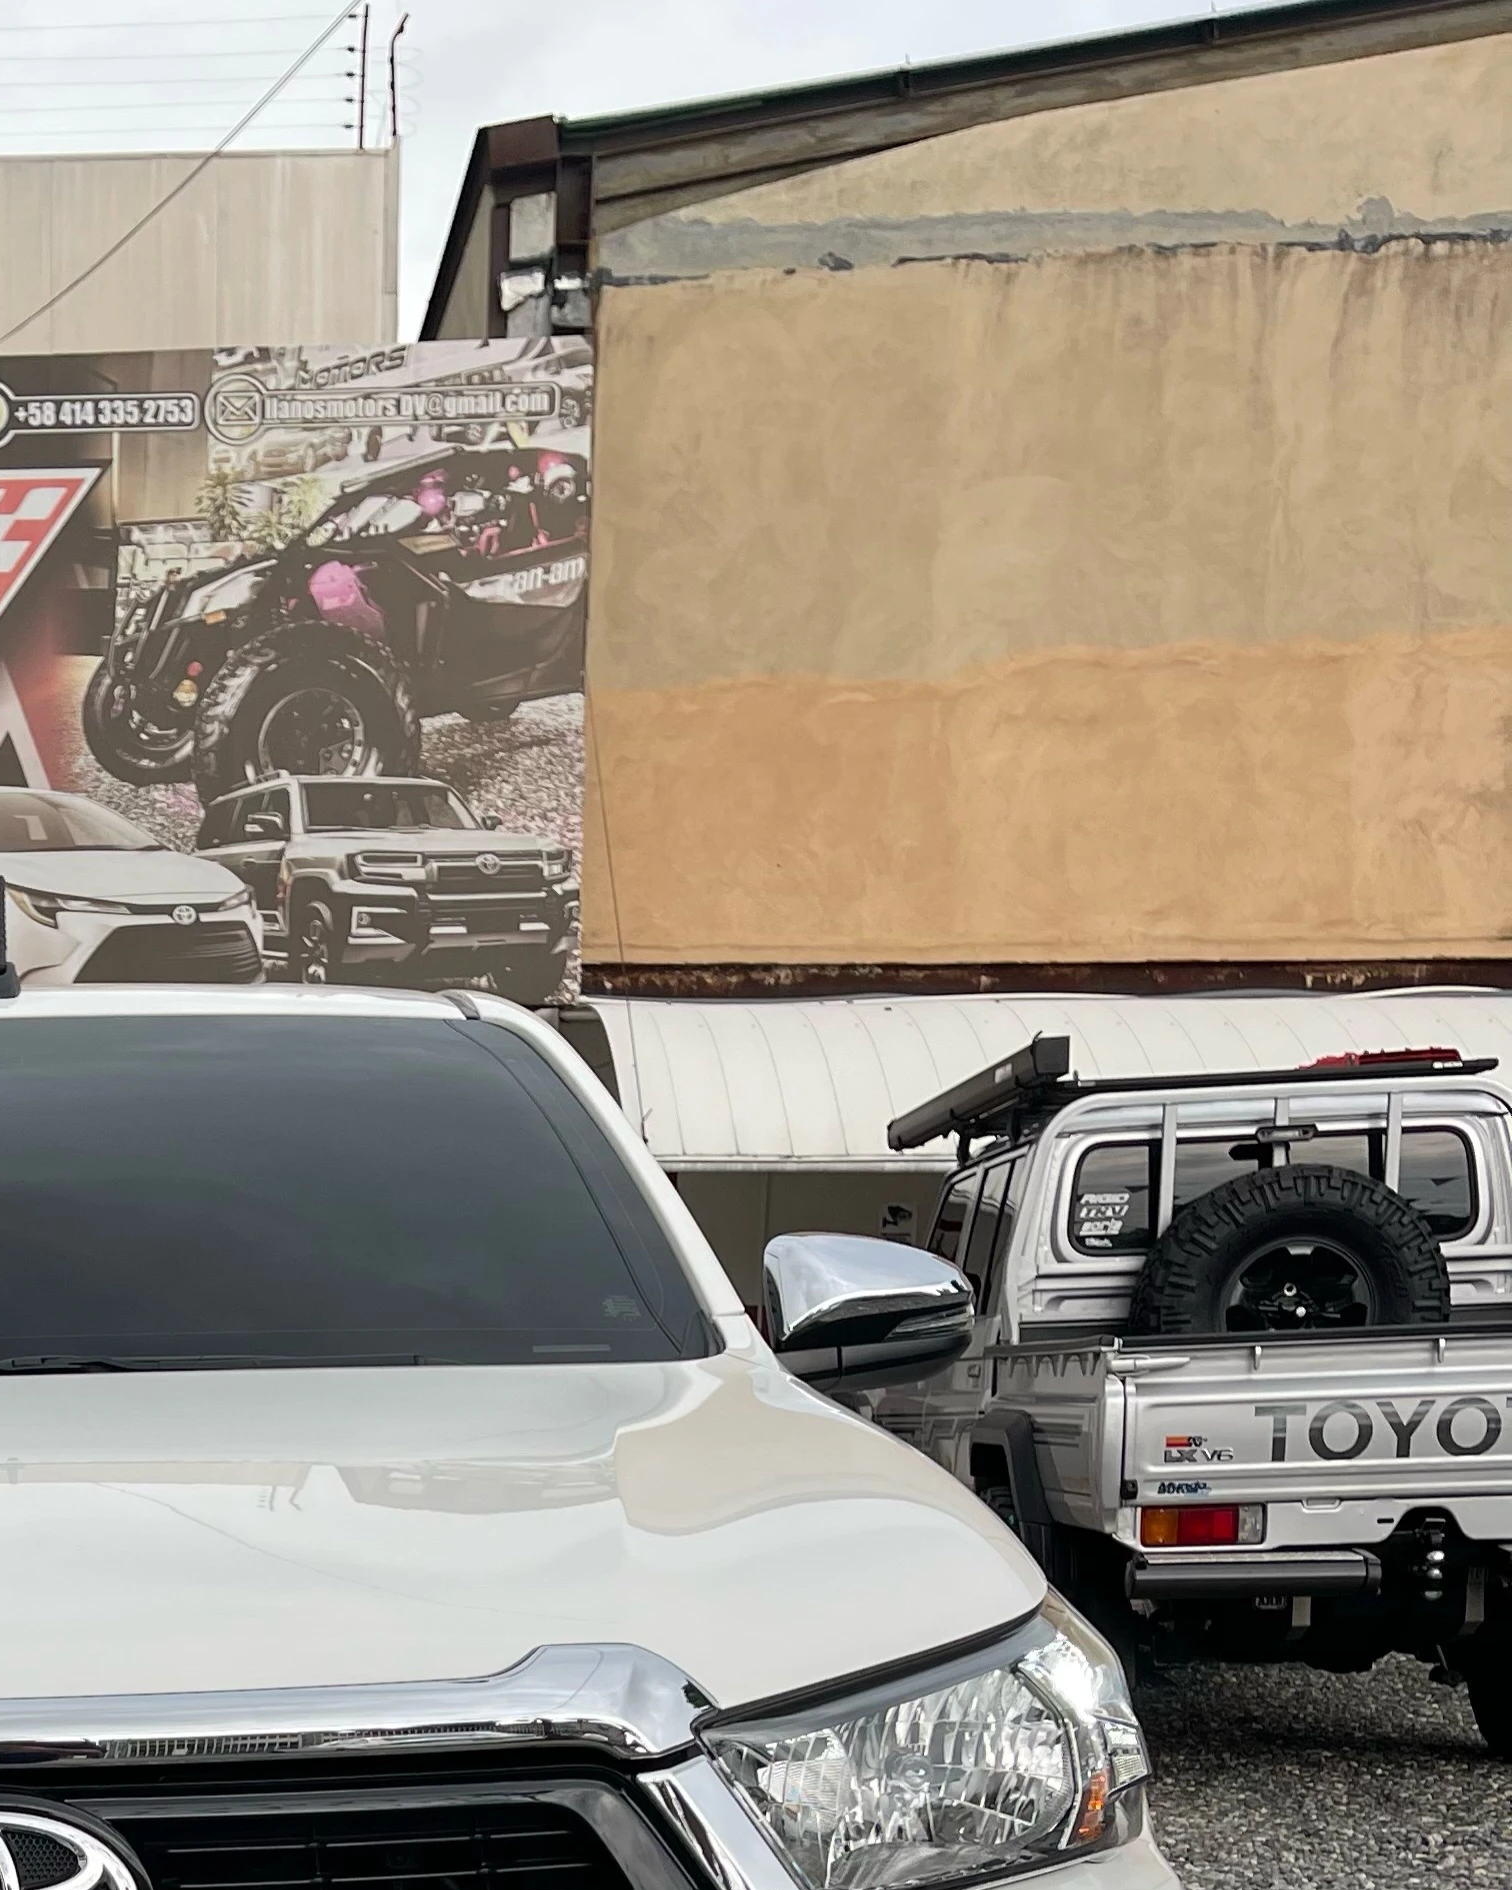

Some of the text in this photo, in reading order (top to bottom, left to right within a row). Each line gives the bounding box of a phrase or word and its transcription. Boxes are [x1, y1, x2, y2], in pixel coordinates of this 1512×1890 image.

[14, 399, 193, 426] +58 414 335 2753
